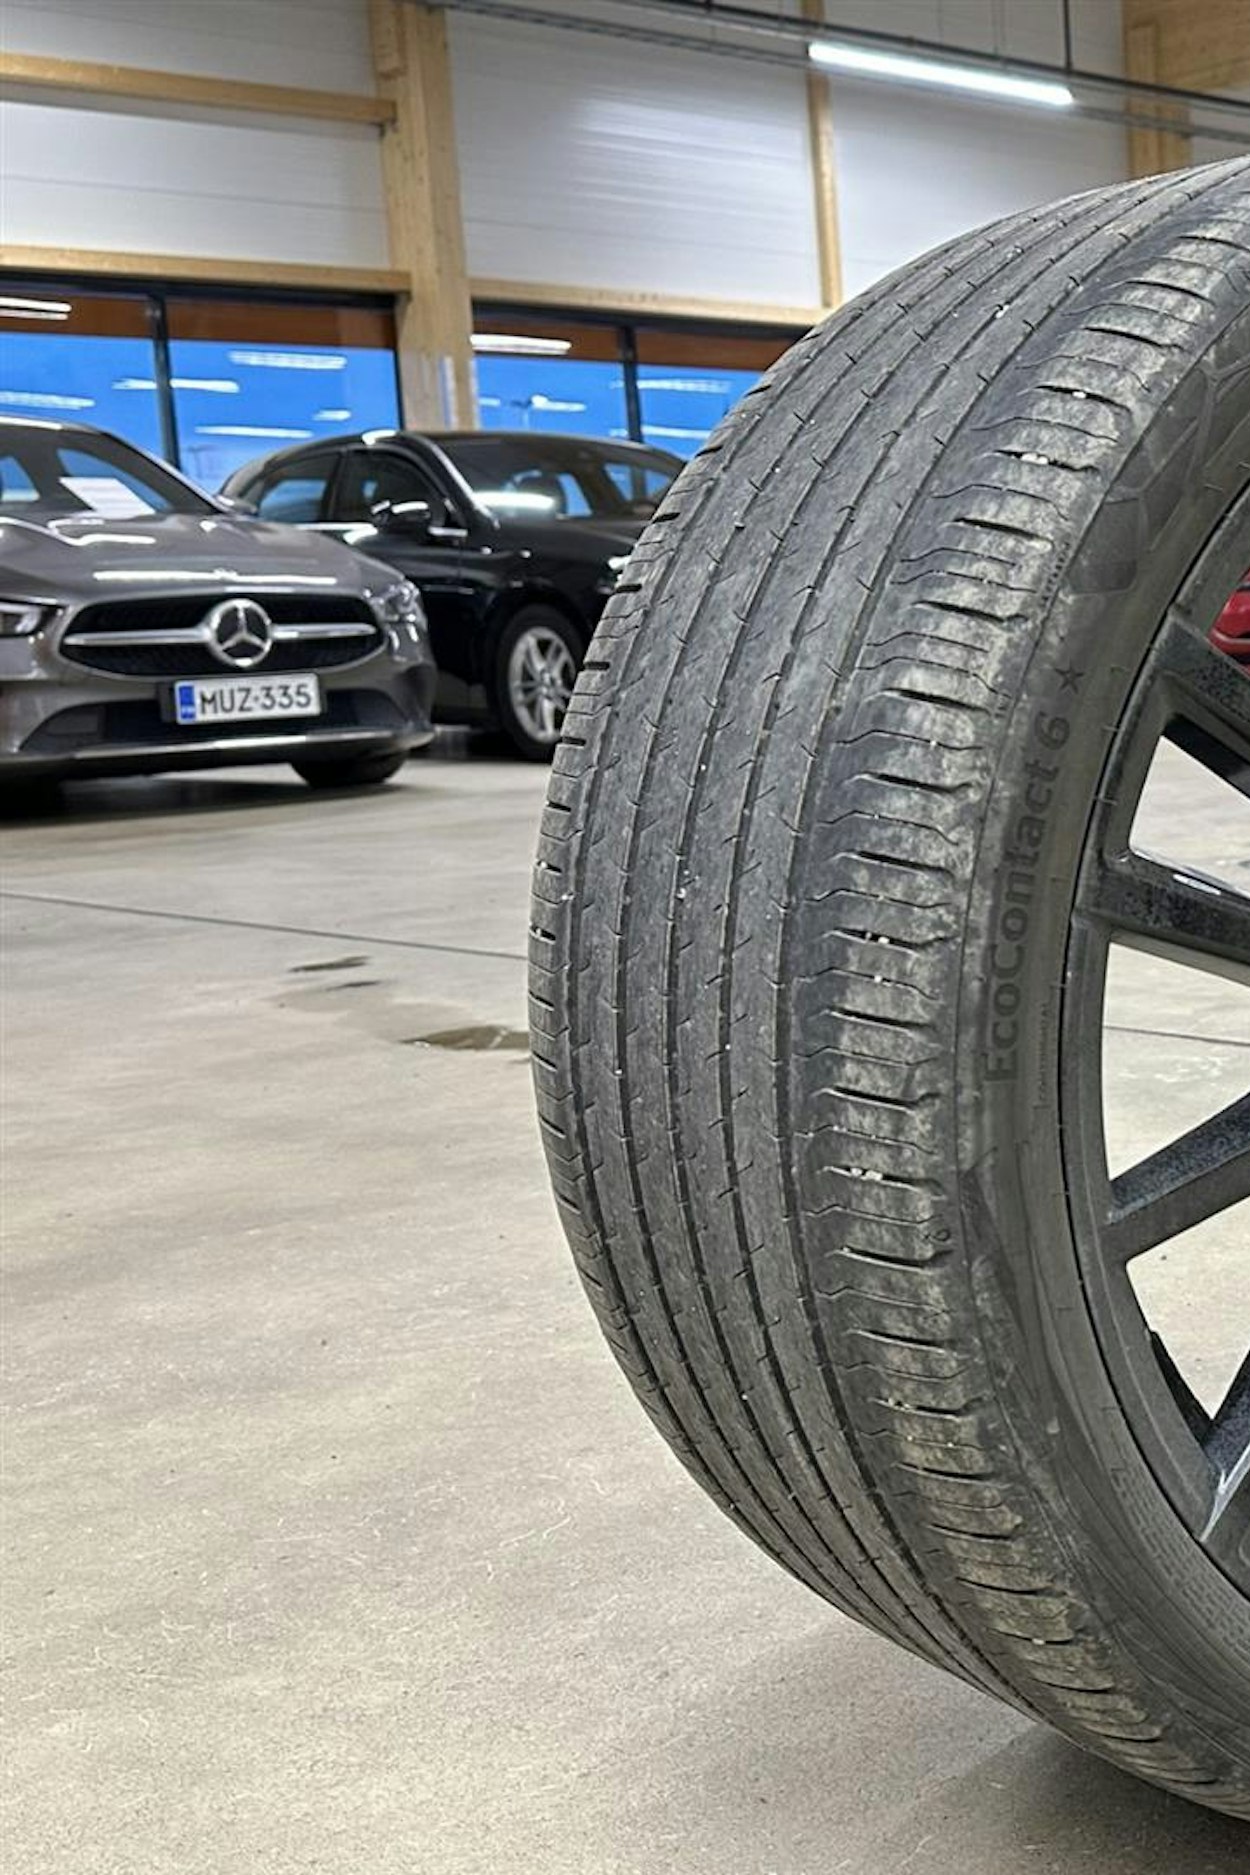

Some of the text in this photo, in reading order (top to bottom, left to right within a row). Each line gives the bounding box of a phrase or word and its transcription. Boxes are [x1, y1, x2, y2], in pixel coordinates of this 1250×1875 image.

[199, 684, 312, 715] MUZ-335
[982, 710, 1071, 1083] EcoContact 6
